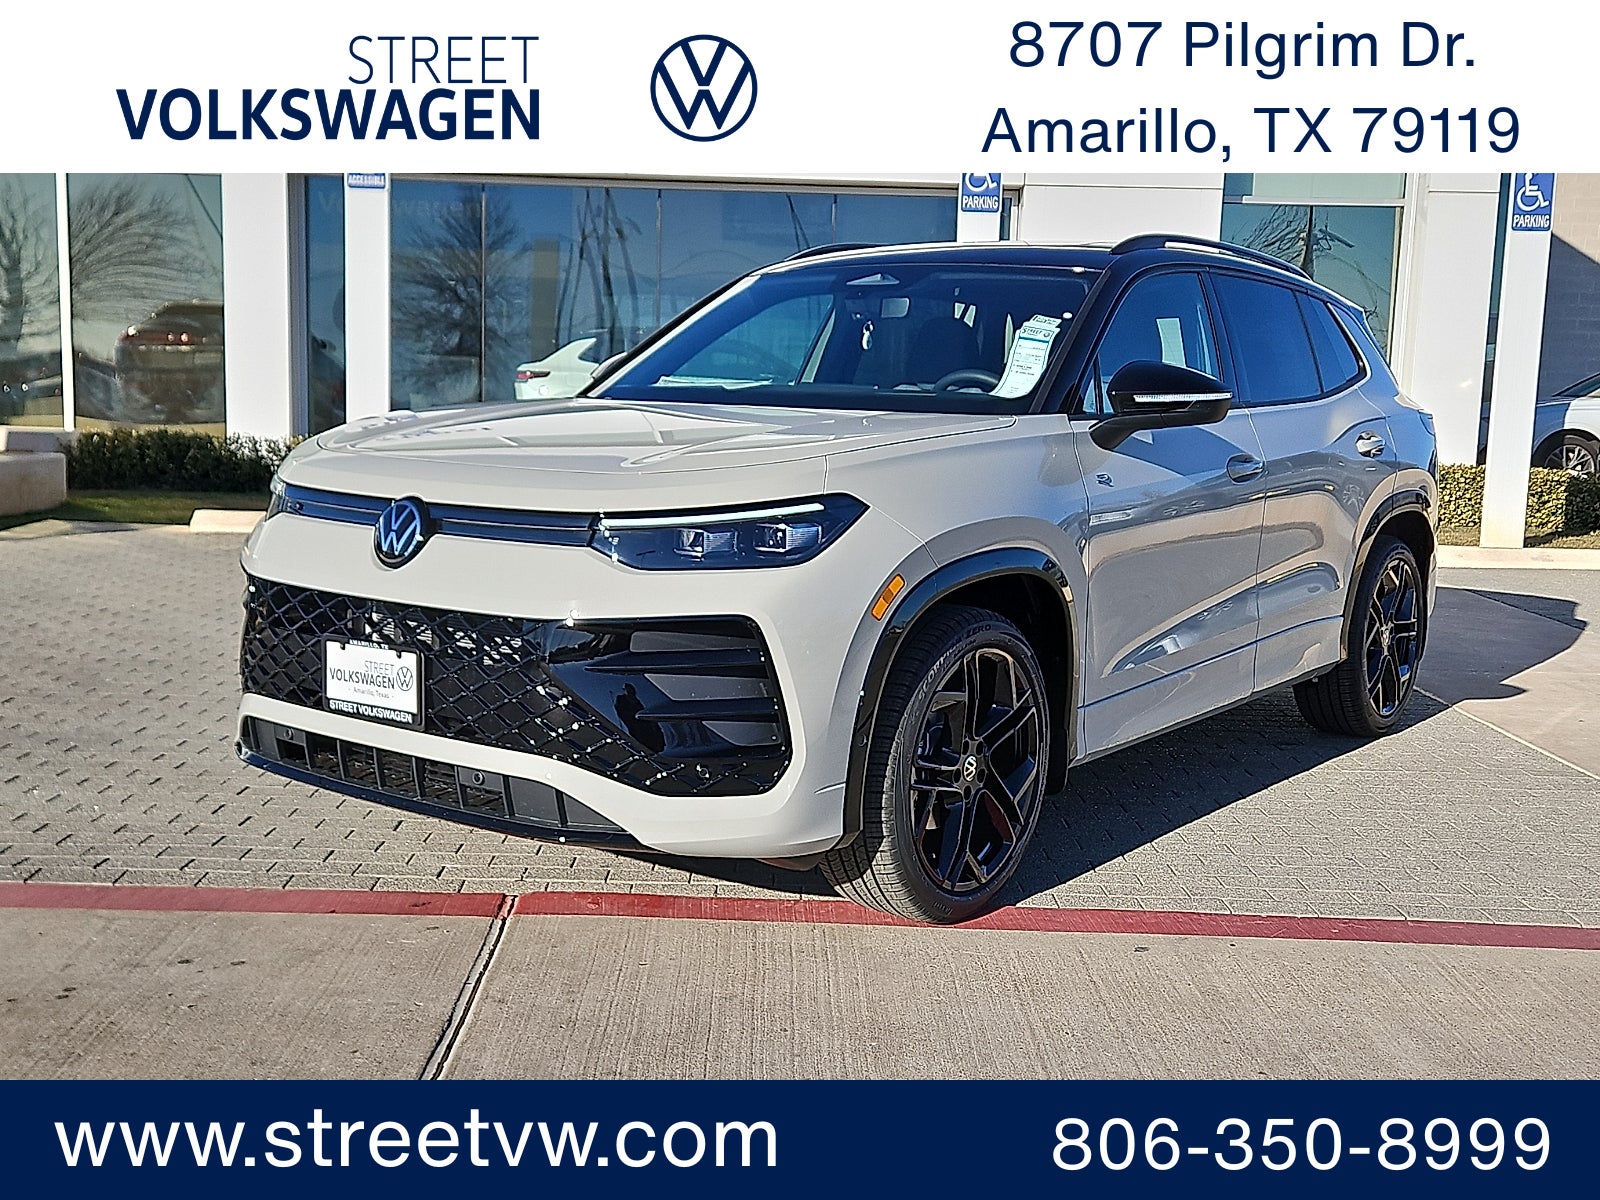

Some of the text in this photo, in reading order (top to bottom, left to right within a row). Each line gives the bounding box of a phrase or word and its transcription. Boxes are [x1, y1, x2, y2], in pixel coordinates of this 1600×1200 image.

[962, 195, 999, 209] PARKING
[1512, 214, 1550, 228] PARKING
[364, 660, 395, 676] STREET
[329, 667, 395, 690] VOLKSWAGEN
[329, 699, 413, 724] STREET VOLKSWAGEN
